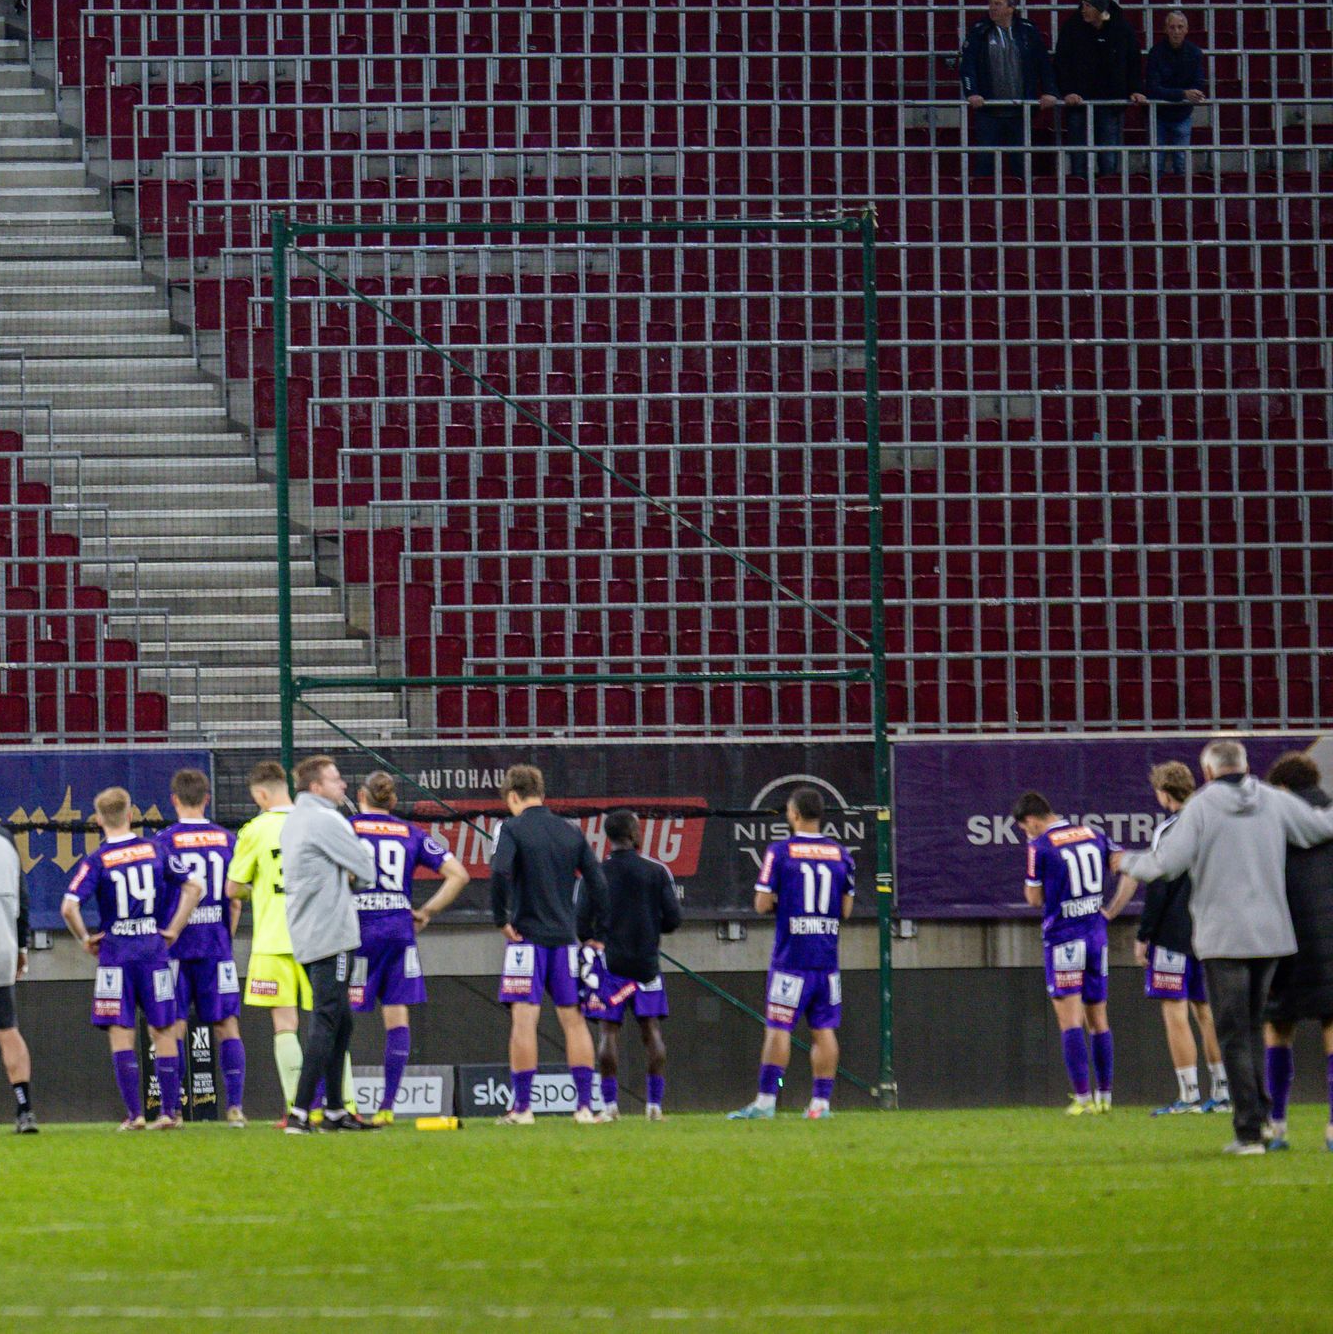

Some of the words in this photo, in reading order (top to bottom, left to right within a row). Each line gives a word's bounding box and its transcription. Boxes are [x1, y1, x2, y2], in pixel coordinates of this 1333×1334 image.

[418, 769, 505, 789] AUTOHAU
[734, 822, 865, 841] NISAN
[966, 814, 1021, 846] SK
[109, 863, 157, 919] 14
[800, 861, 832, 915] 11
[1060, 842, 1103, 898] 10
